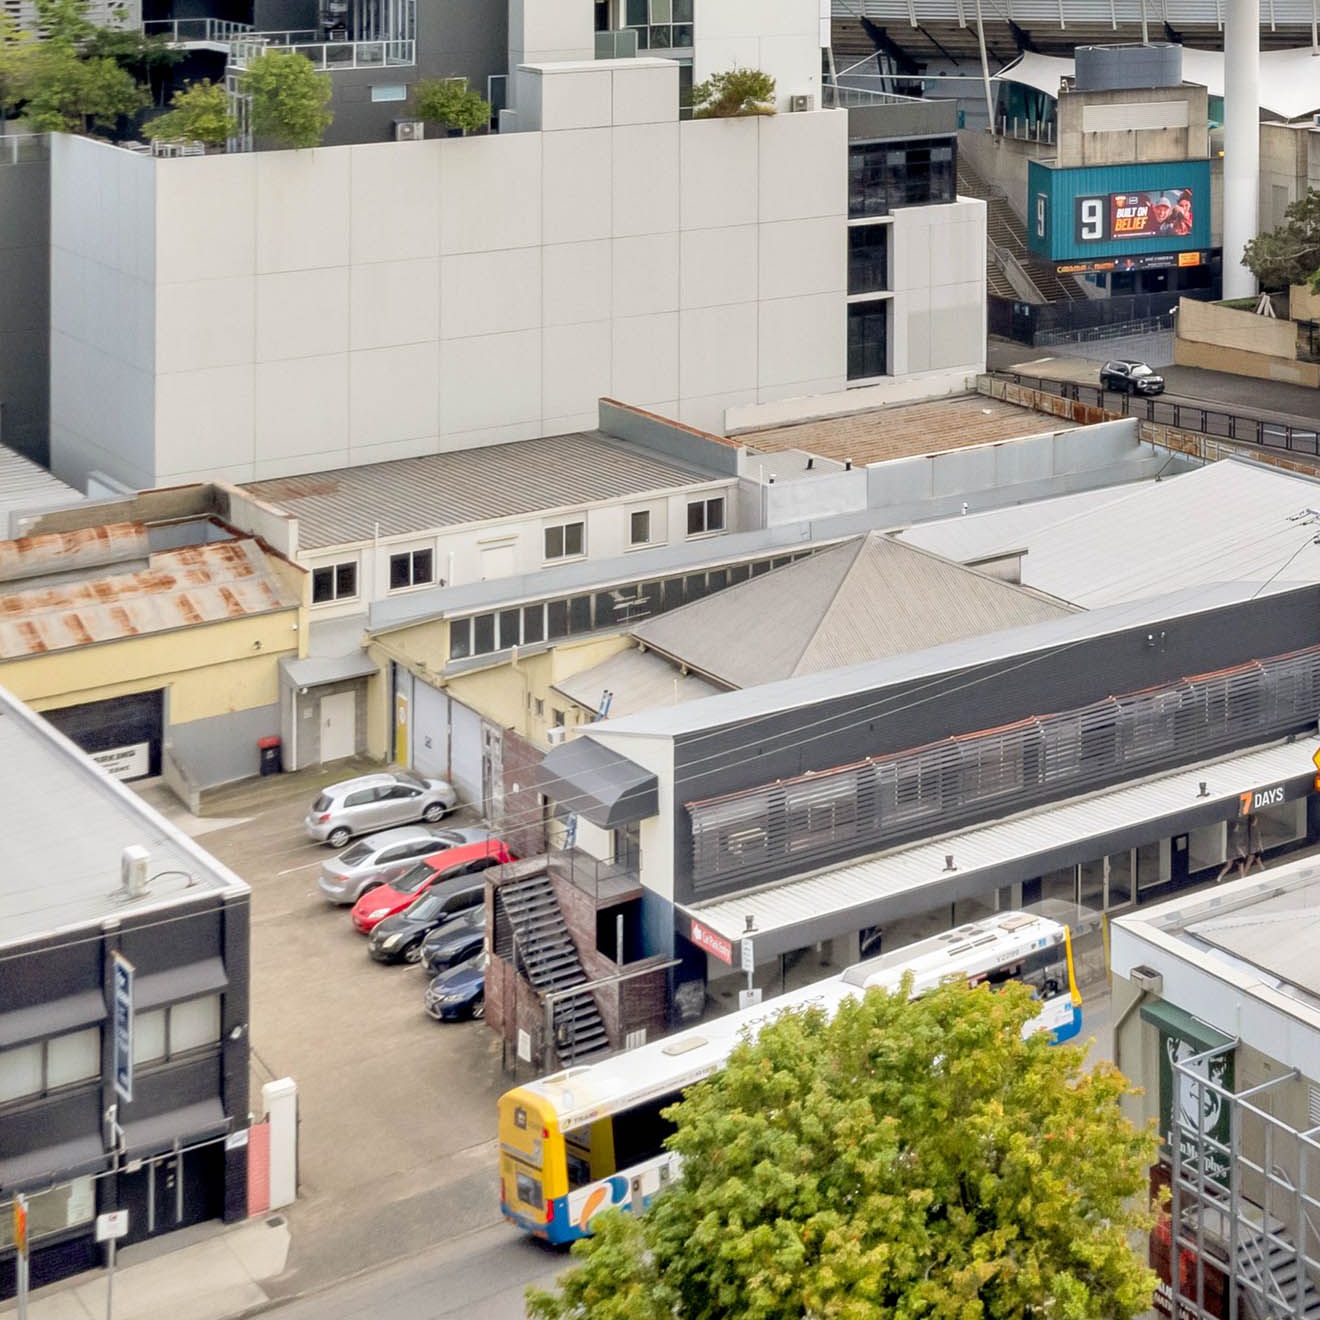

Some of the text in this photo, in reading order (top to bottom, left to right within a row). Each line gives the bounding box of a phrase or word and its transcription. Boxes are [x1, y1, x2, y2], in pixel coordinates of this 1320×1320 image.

[1082, 199, 1103, 239] 9
[1116, 206, 1148, 219] BUILT ON
[1114, 217, 1148, 231] BELIEF
[1239, 787, 1284, 816] 7 DAYS
